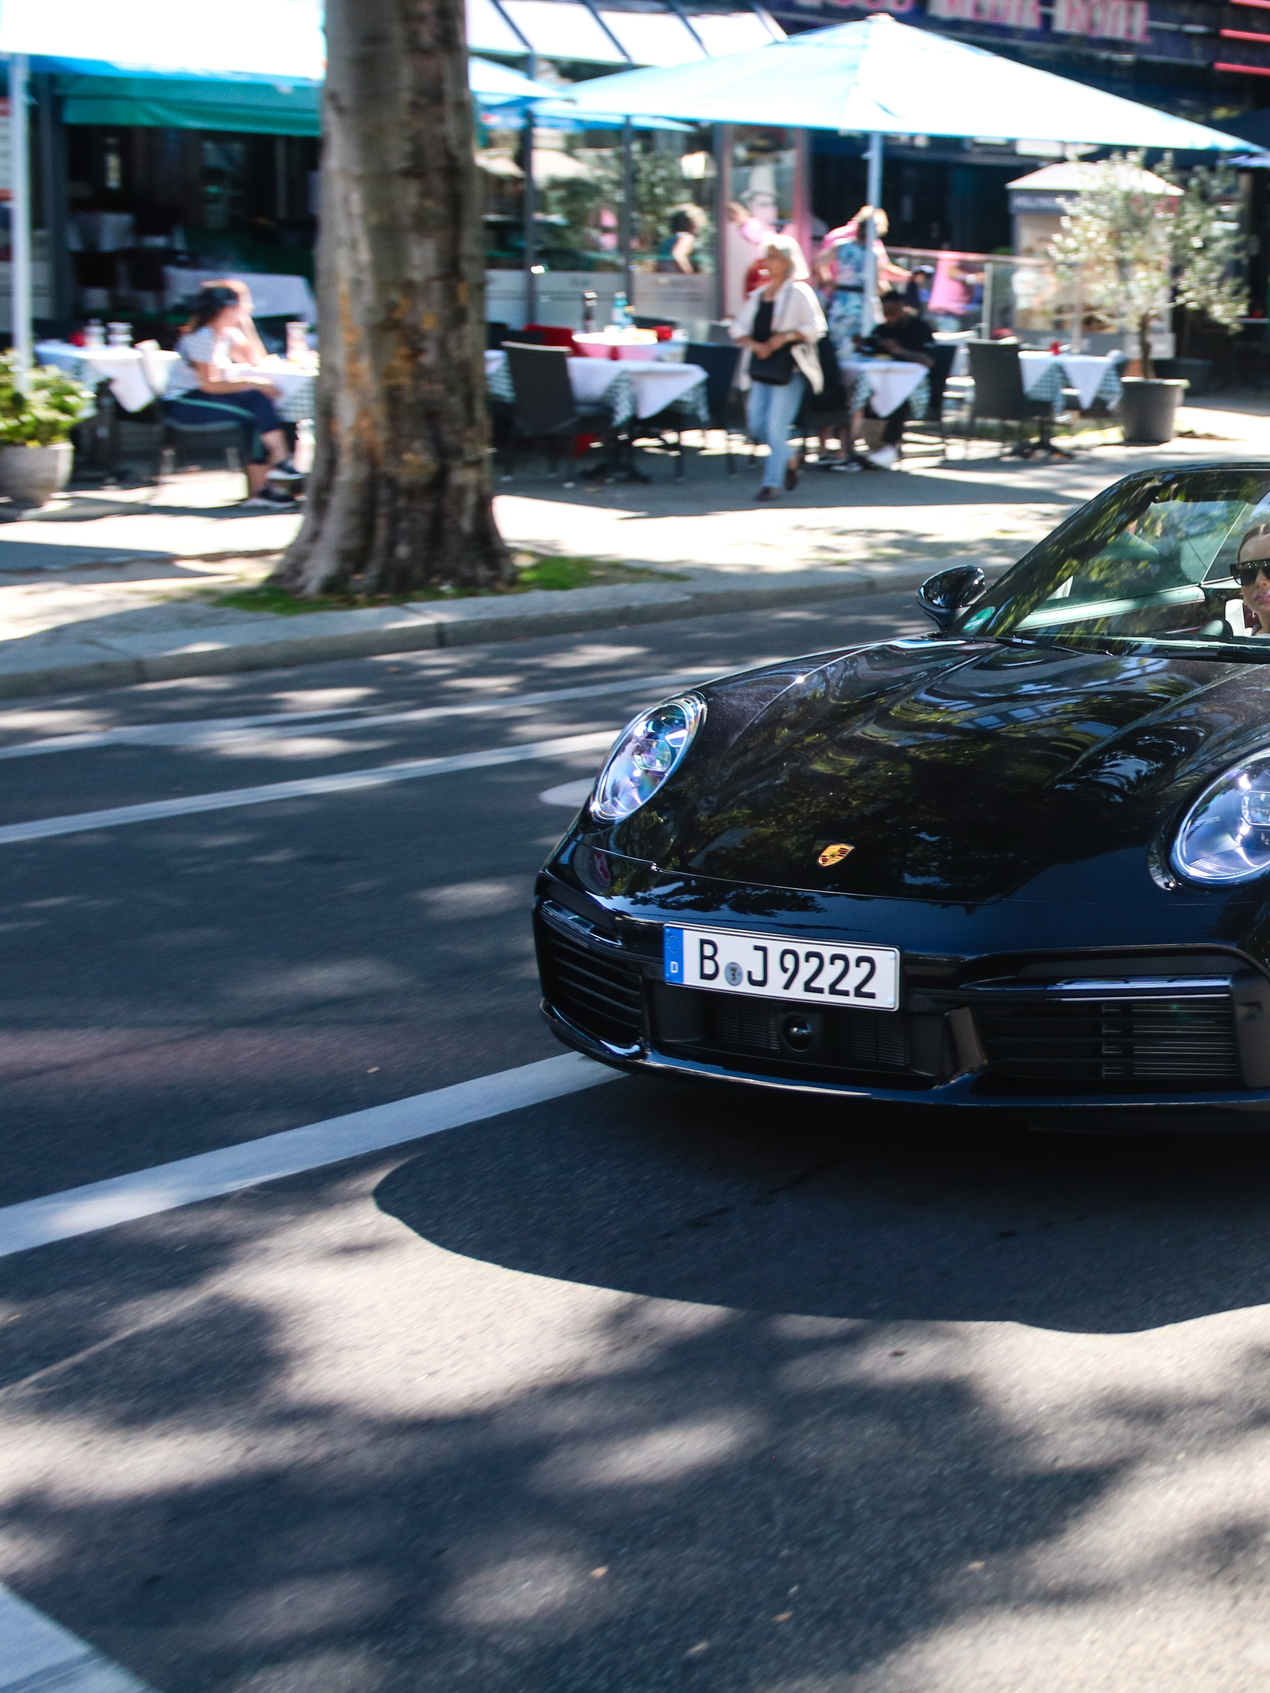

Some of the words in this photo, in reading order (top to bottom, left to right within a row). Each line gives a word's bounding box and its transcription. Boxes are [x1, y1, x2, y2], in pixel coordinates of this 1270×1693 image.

[670, 961, 679, 974] D
[699, 938, 720, 981] B
[779, 948, 877, 1000] 9222
